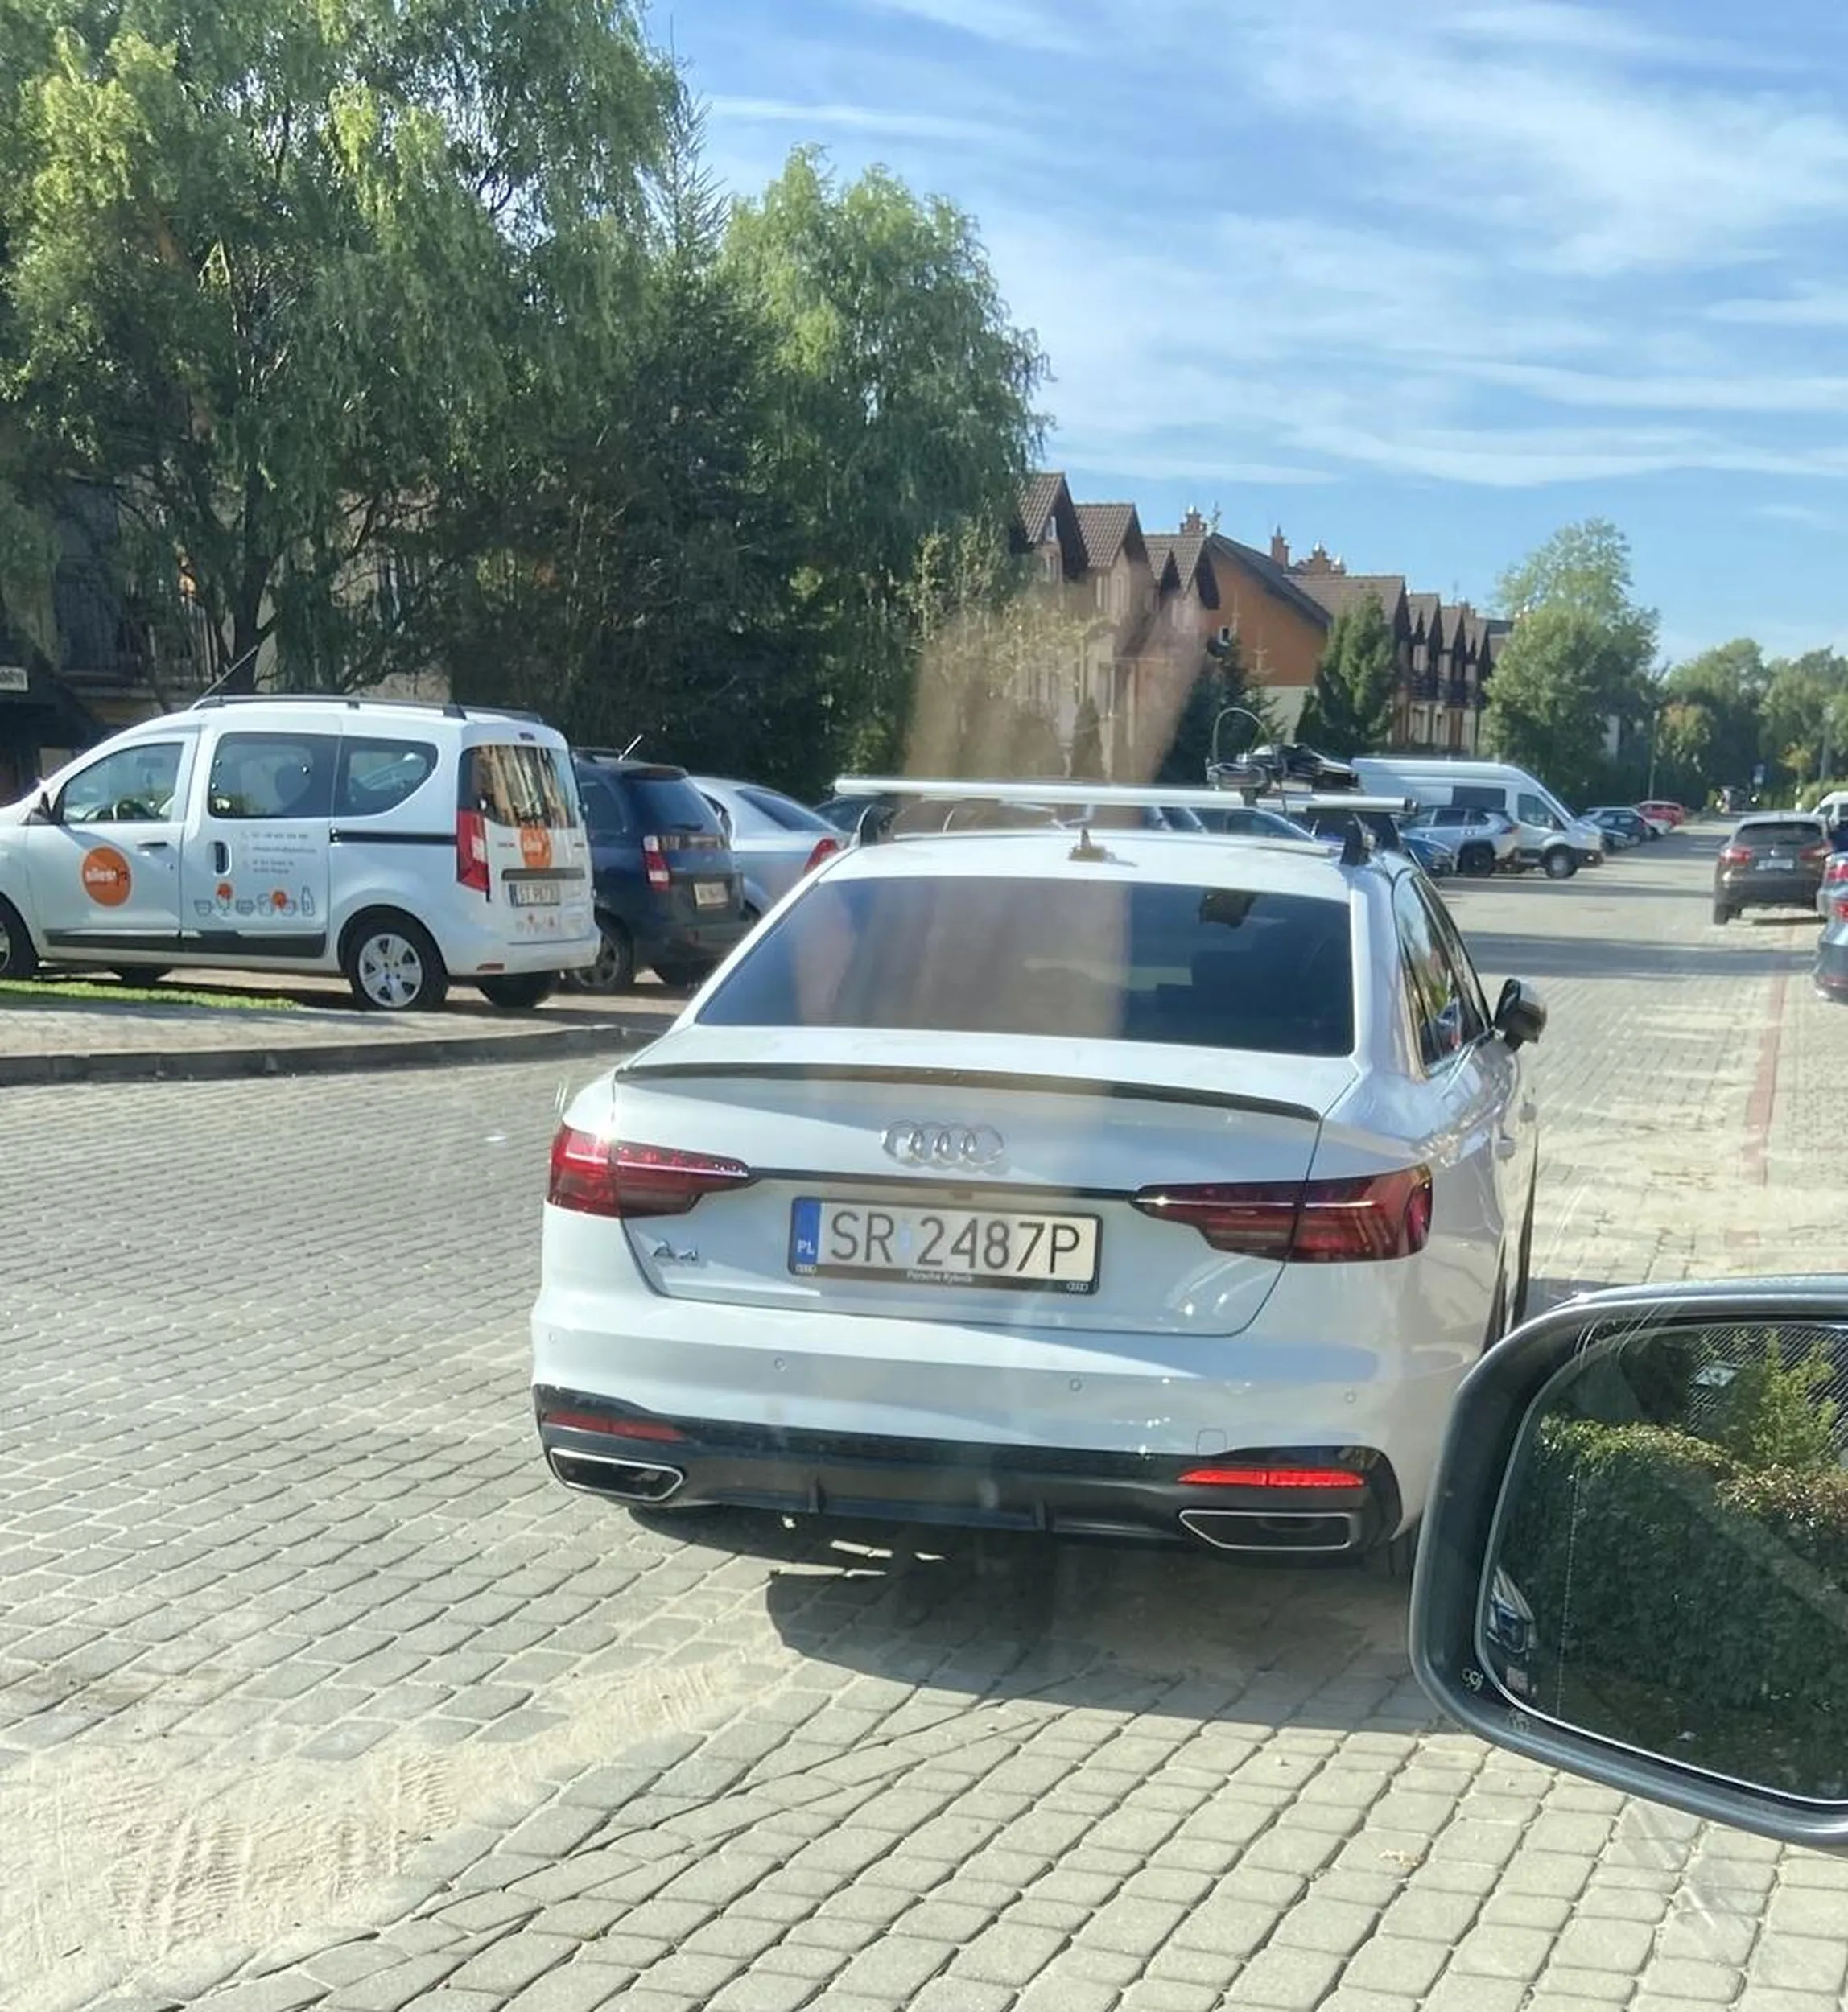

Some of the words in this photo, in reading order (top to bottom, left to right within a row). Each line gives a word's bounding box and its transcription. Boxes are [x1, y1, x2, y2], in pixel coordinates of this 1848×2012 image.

[798, 1240, 815, 1255] PL
[831, 1211, 894, 1262] SR
[916, 1216, 1080, 1274] 2487P
